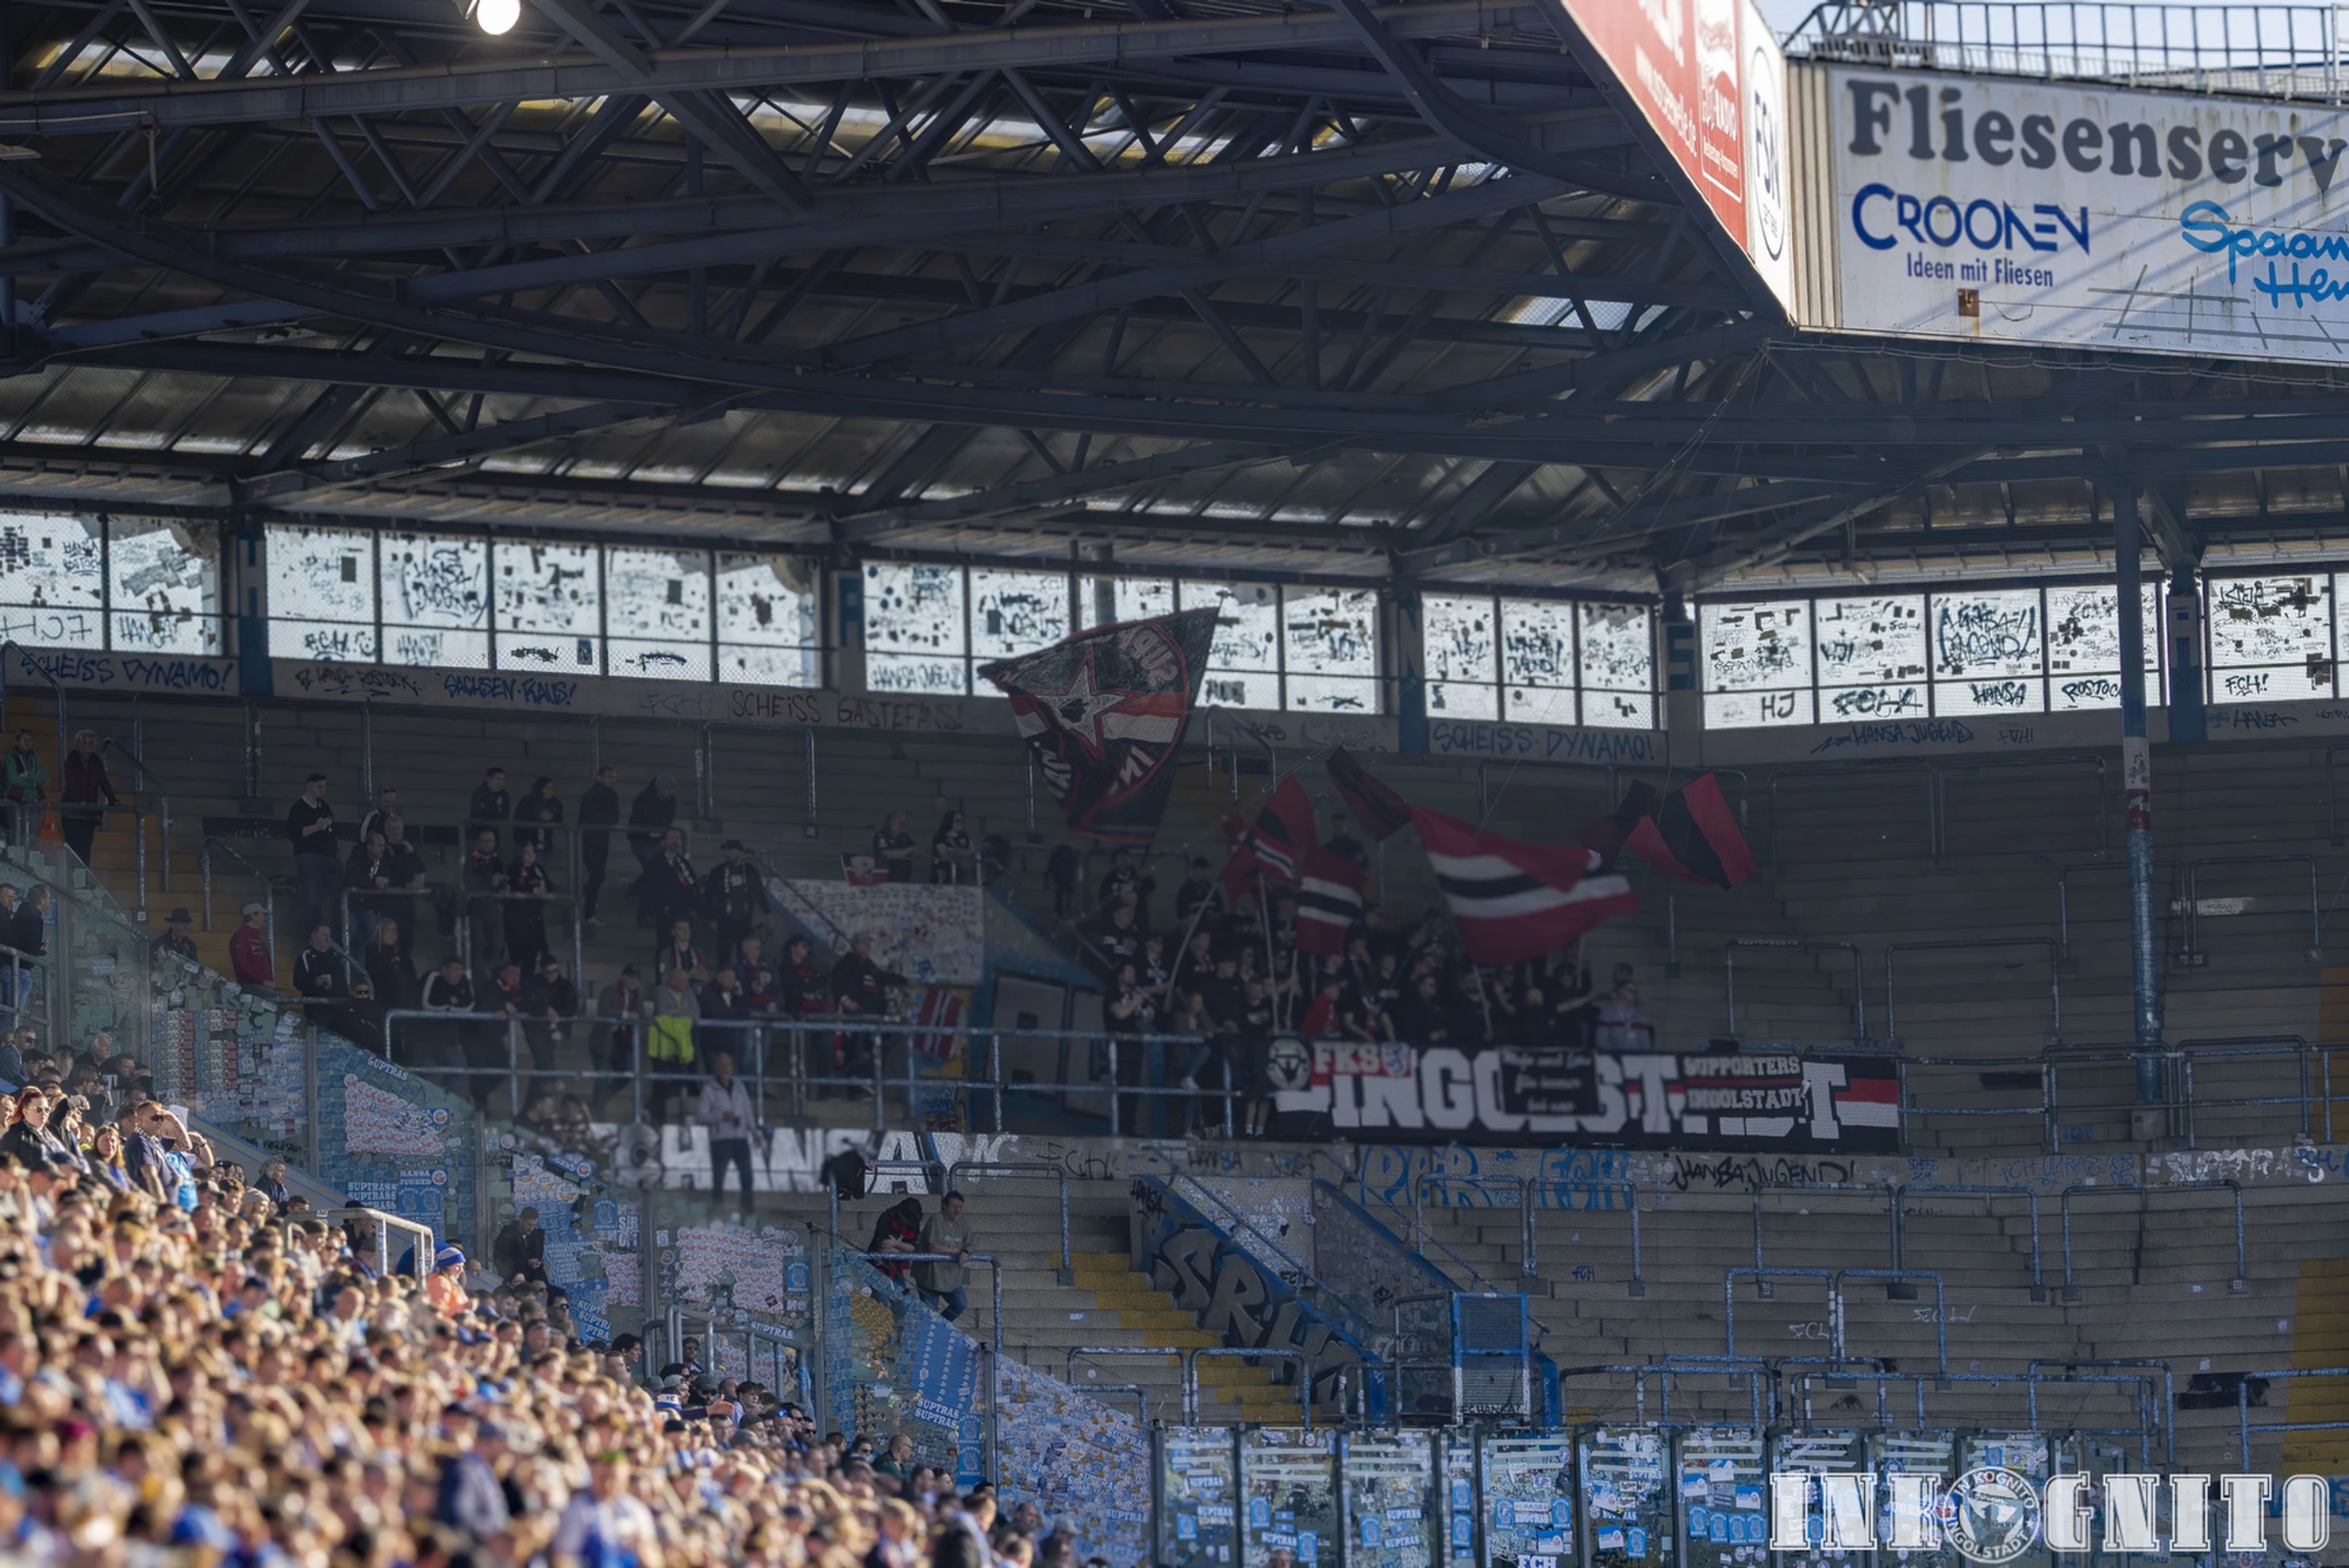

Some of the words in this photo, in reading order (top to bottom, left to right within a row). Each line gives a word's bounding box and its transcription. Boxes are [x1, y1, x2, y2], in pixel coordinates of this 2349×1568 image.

[1852, 183, 2089, 255] CROONEN
[1907, 253, 1954, 280] Ideen
[1960, 258, 1988, 284] mit
[1994, 258, 2054, 288] Fliesen
[121, 657, 233, 692] DYNAMO!
[1761, 692, 1795, 722] HJ
[1970, 681, 2027, 706] HANSA
[1432, 721, 1534, 752] SCHEISS
[1548, 728, 1655, 760] DYNAMO!
[1313, 1041, 1379, 1074] FKS
[1682, 1055, 1801, 1077] SUPPORTERS
[914, 1408, 958, 1428] SUPTRAS
[917, 1397, 960, 1419] SUPTRAS
[1386, 1508, 1422, 1520] SUPTRAS
[1517, 1555, 1558, 1568] FCH
